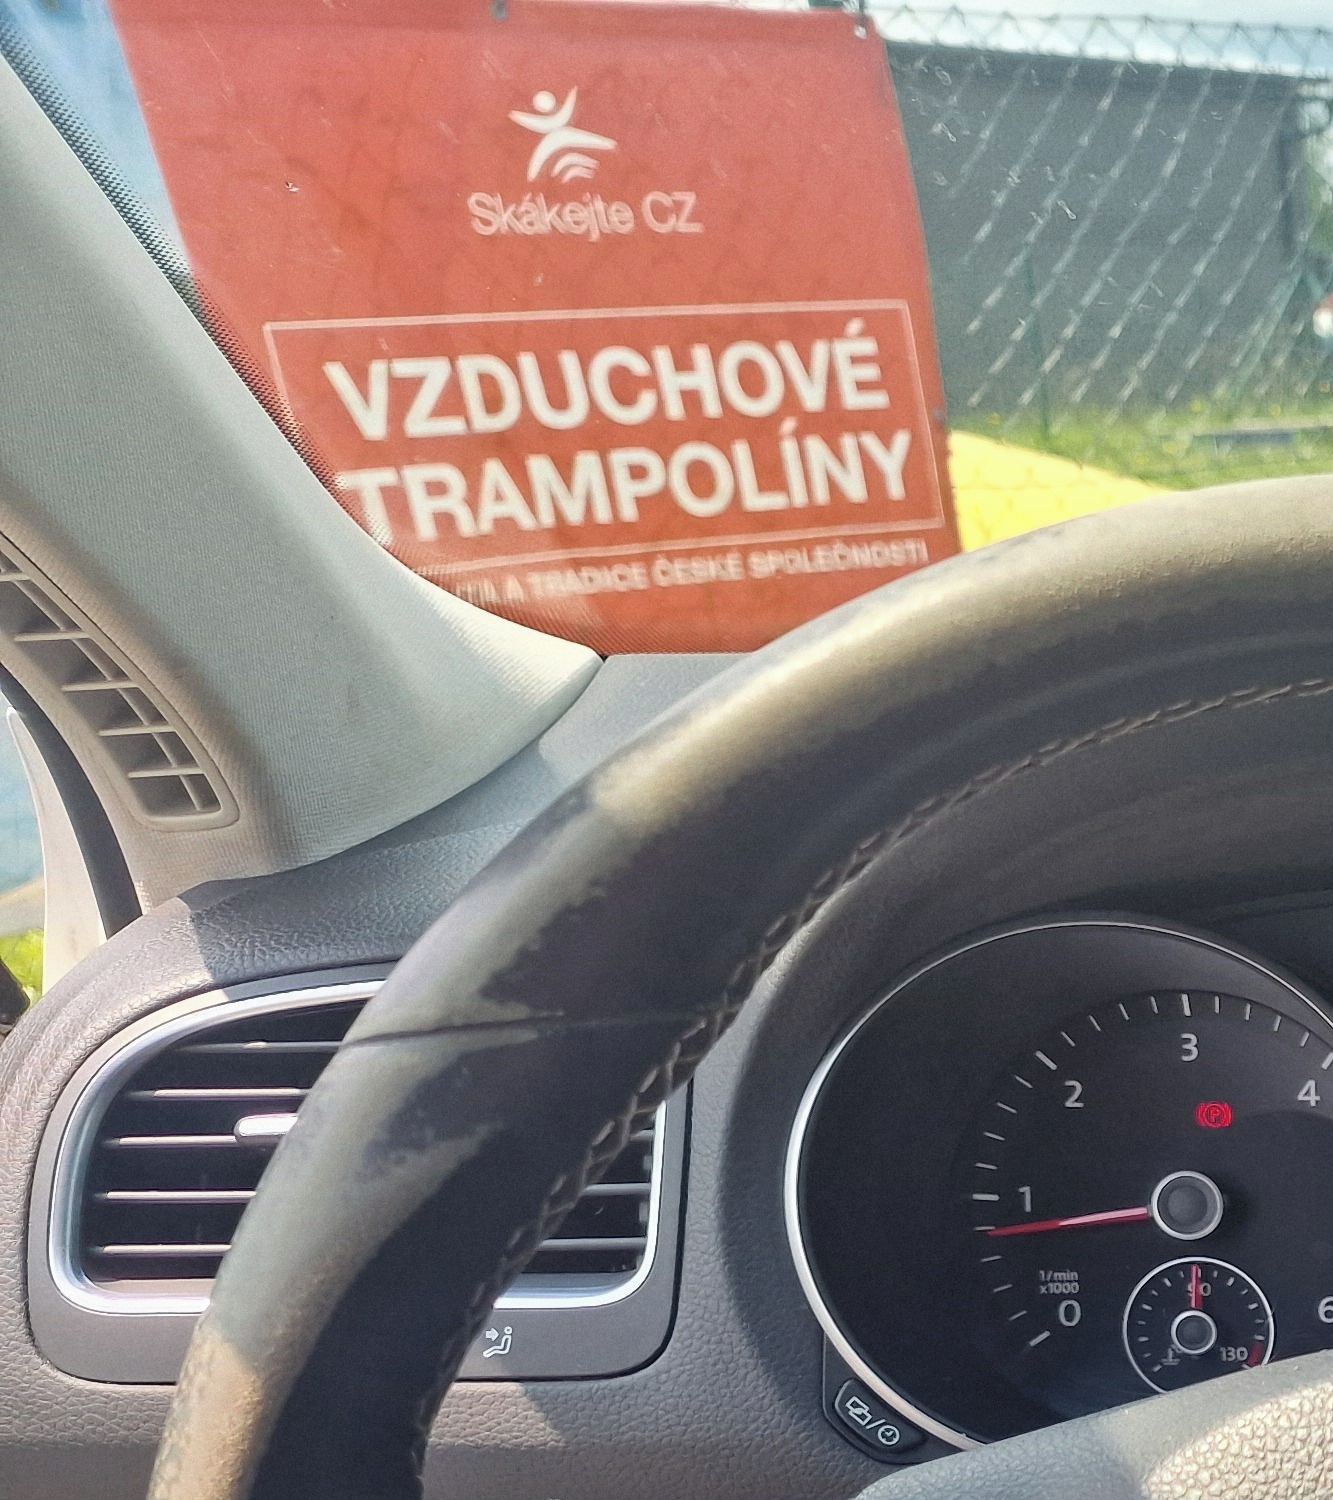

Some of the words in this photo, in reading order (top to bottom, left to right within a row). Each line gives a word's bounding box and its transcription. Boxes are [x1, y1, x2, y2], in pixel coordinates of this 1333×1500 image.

[468, 193, 633, 240] Skákejte
[641, 192, 704, 234] CZ
[322, 318, 890, 443] VZDUCHOVÉ
[341, 418, 913, 541] TRAMPOLÍNY
[655, 550, 743, 587] ČESKÉ
[748, 538, 928, 578] SPOLEČNOSTI
[1180, 1033, 1199, 1062] 3
[1064, 1080, 1084, 1109] 2
[1297, 1080, 1320, 1107] 4
[1018, 1186, 1032, 1212] 1
[1038, 1269, 1079, 1283] 1/min
[1039, 1283, 1080, 1294] x1000
[1059, 1300, 1081, 1327] 0
[1220, 1347, 1248, 1361] 130
